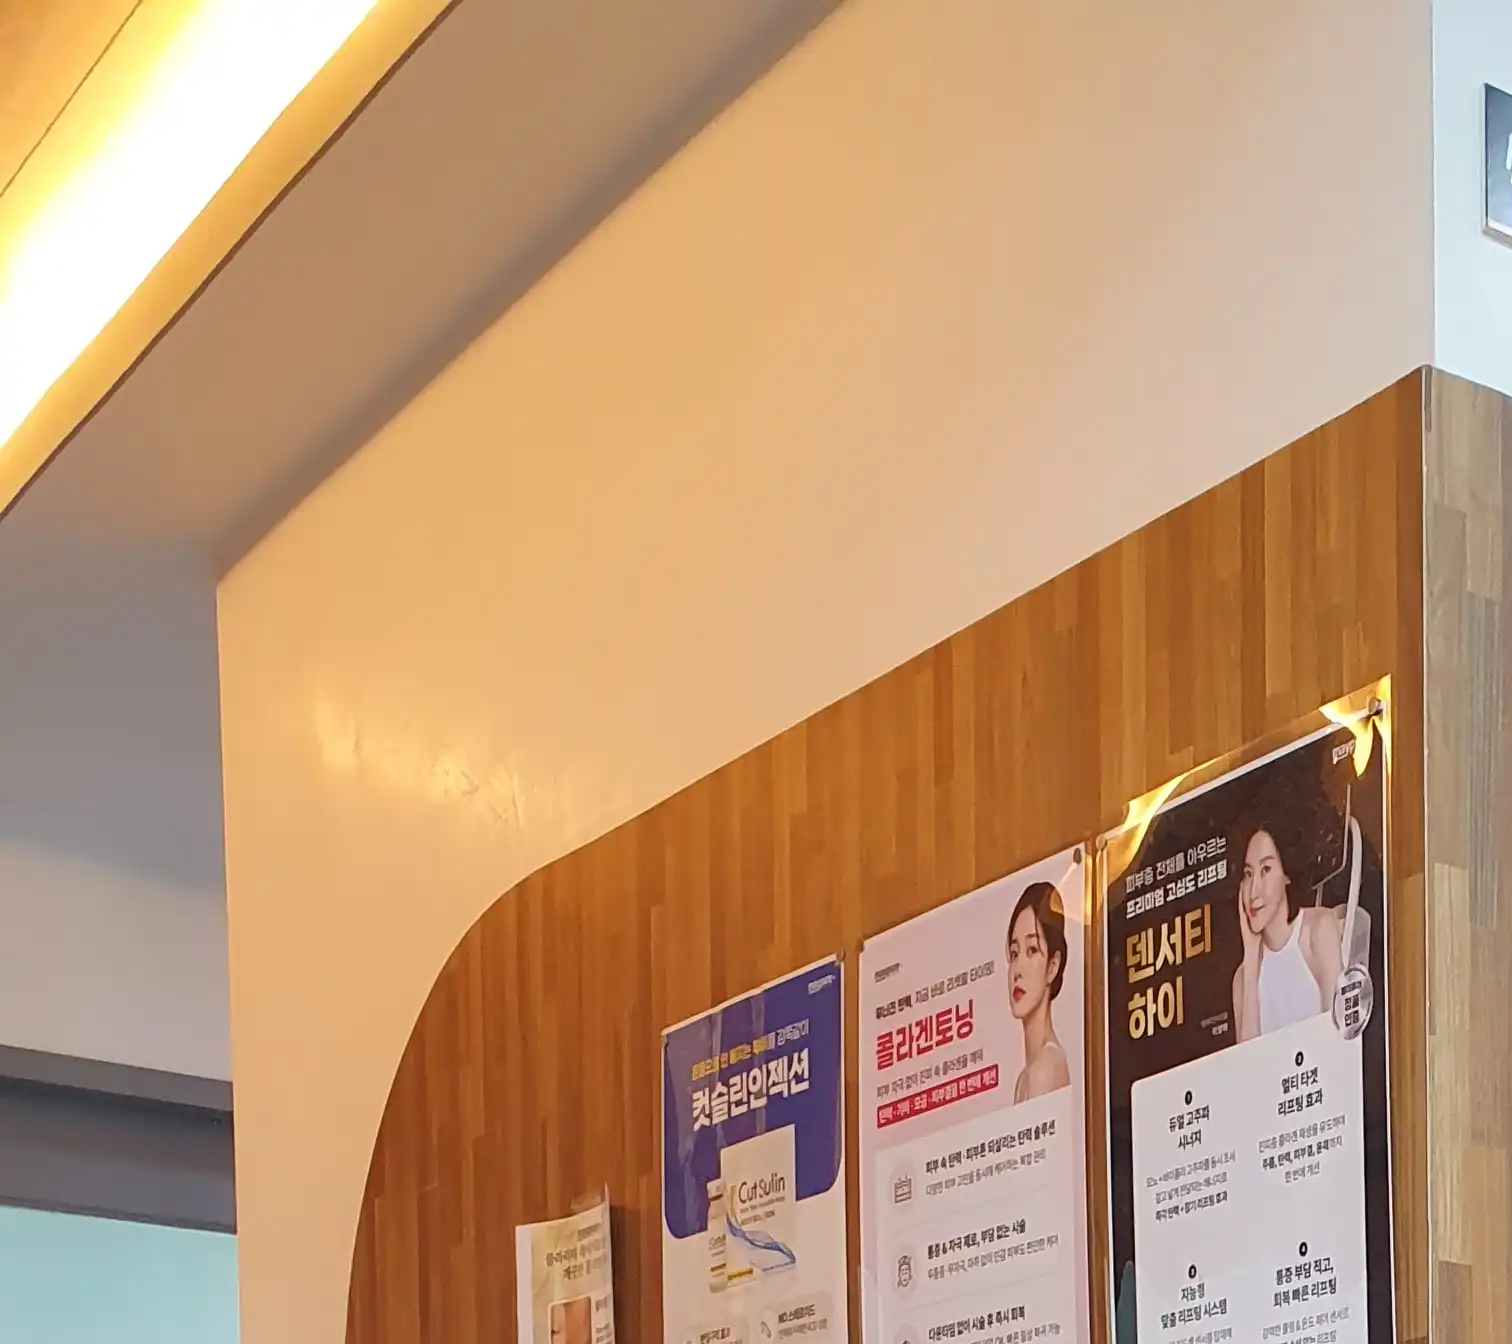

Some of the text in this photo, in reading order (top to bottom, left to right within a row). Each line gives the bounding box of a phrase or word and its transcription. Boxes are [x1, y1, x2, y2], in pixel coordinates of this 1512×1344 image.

[1125, 832, 1226, 895] 피부층 전체를 아우르는
[1125, 858, 1227, 920] 프리미엄 고심도 리프팅
[1125, 902, 1212, 985] 덴서티
[1127, 974, 1184, 1044] 하이
[875, 998, 973, 1071] 콜라겐토닝
[691, 1046, 809, 1132] 컷슐린인젝션
[1281, 1065, 1318, 1095] 멀티 타겟
[1168, 1104, 1209, 1133] 듀얼 고주파
[1277, 1087, 1323, 1119] 리프팅 효과
[1177, 1128, 1201, 1152] 시너지
[1275, 1255, 1333, 1286] 통증 부담 적고,
[1180, 1281, 1205, 1304] 지능형
[1273, 1276, 1337, 1309] 회복 빠른 리프팅
[1160, 1297, 1227, 1330] 맞춤 리프팅 시스템
